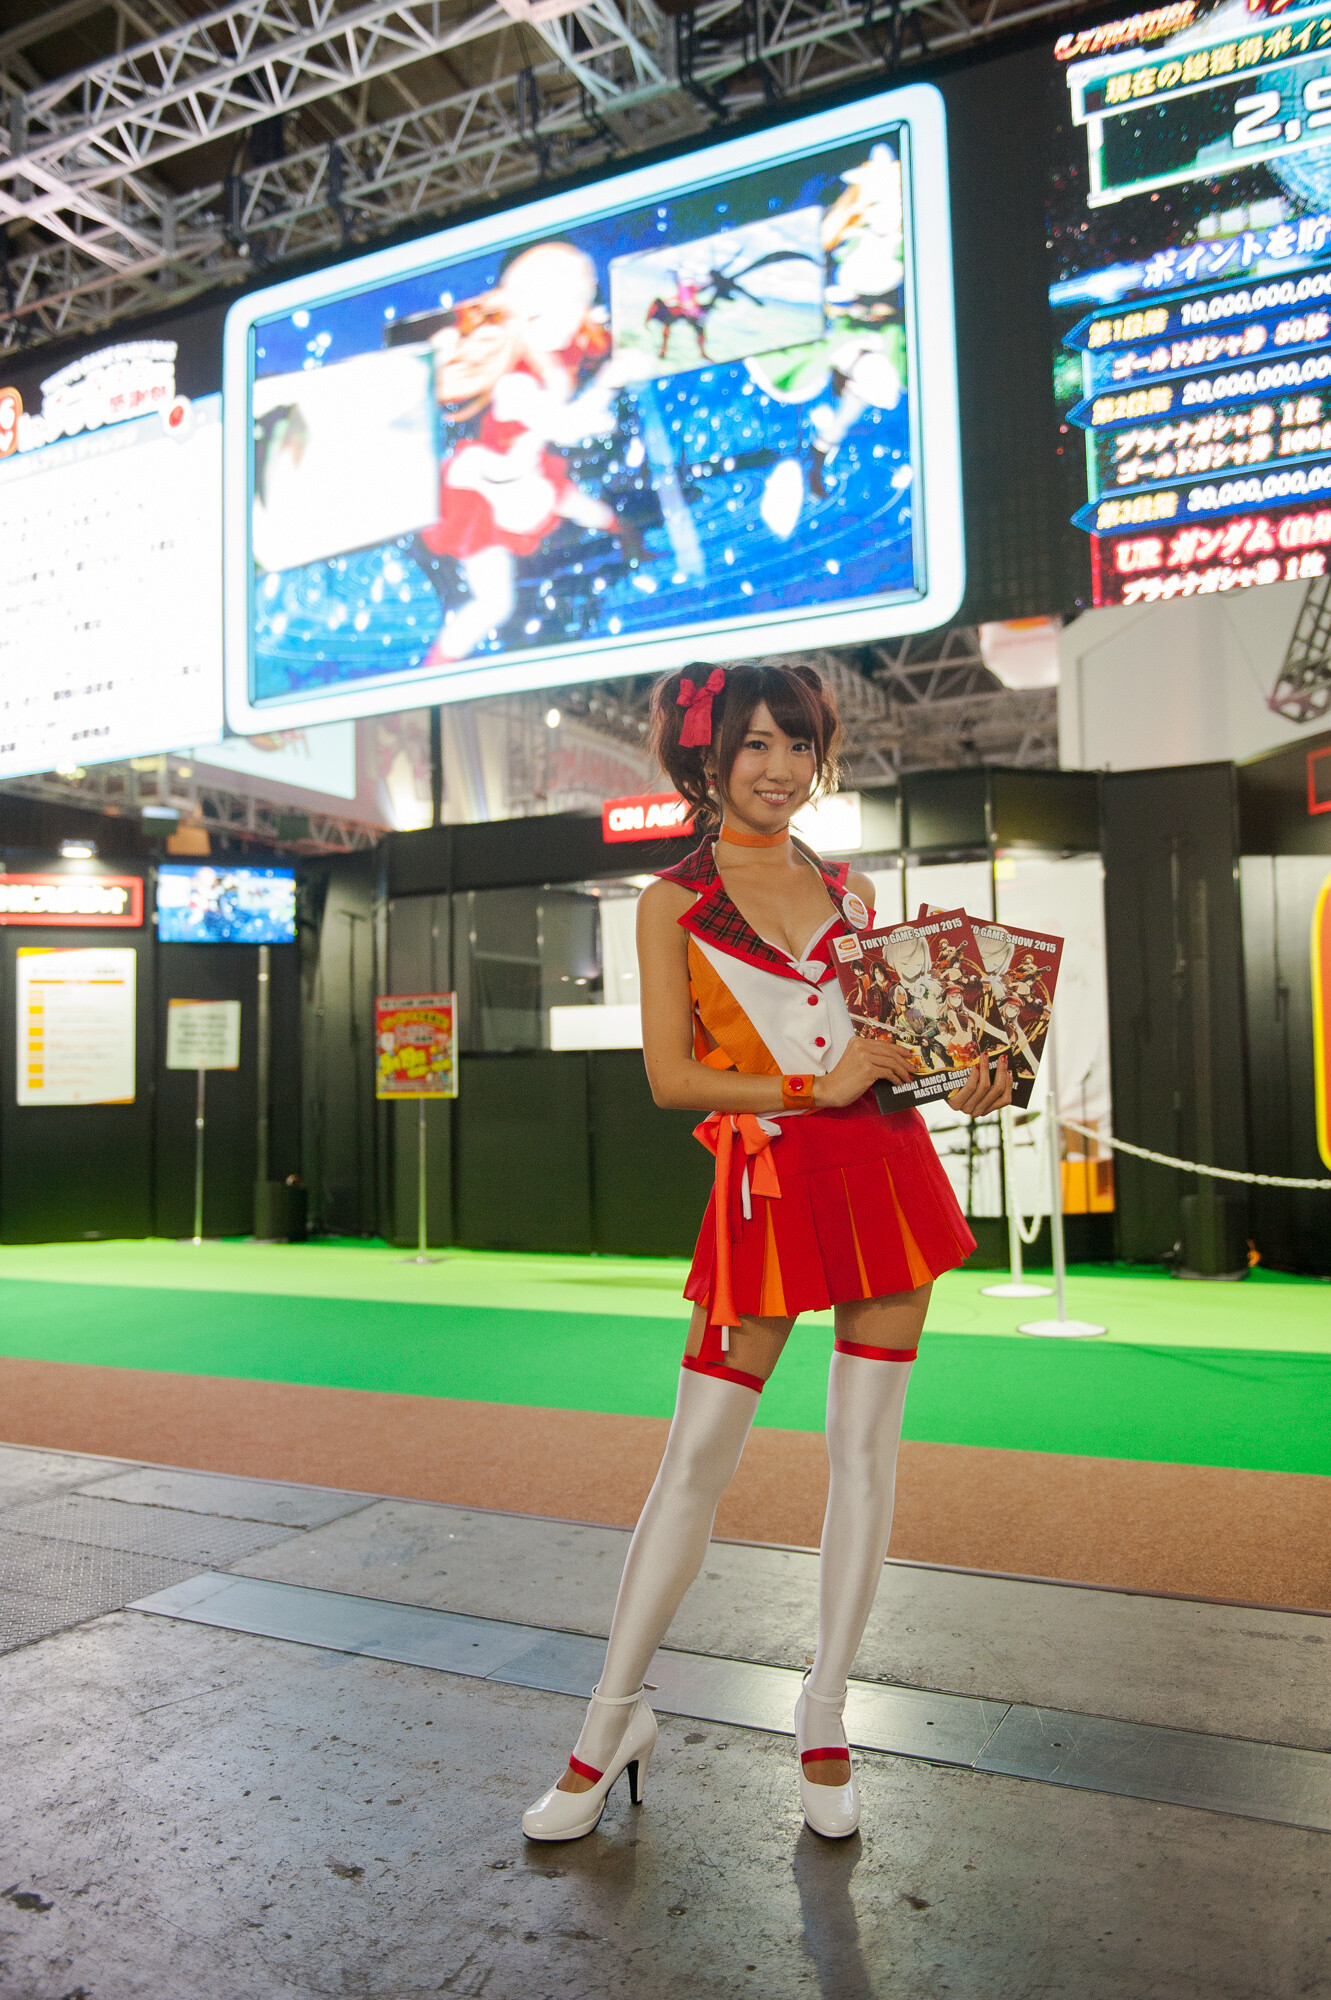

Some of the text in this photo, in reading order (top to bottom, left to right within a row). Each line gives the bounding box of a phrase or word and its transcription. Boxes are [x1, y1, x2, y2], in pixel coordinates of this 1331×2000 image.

[609, 806, 644, 831] ON
[860, 935, 889, 950] TOKYO
[889, 929, 914, 944] GAME
[914, 922, 940, 938] SHOW
[940, 917, 963, 932] 2015
[980, 927, 1005, 941] GAME
[1006, 933, 1034, 948] SHOW
[1034, 940, 1057, 954] 2015
[892, 1081, 919, 1095] BANDAI
[920, 1073, 947, 1088] NAMCO
[913, 1084, 943, 1099] MASTER
